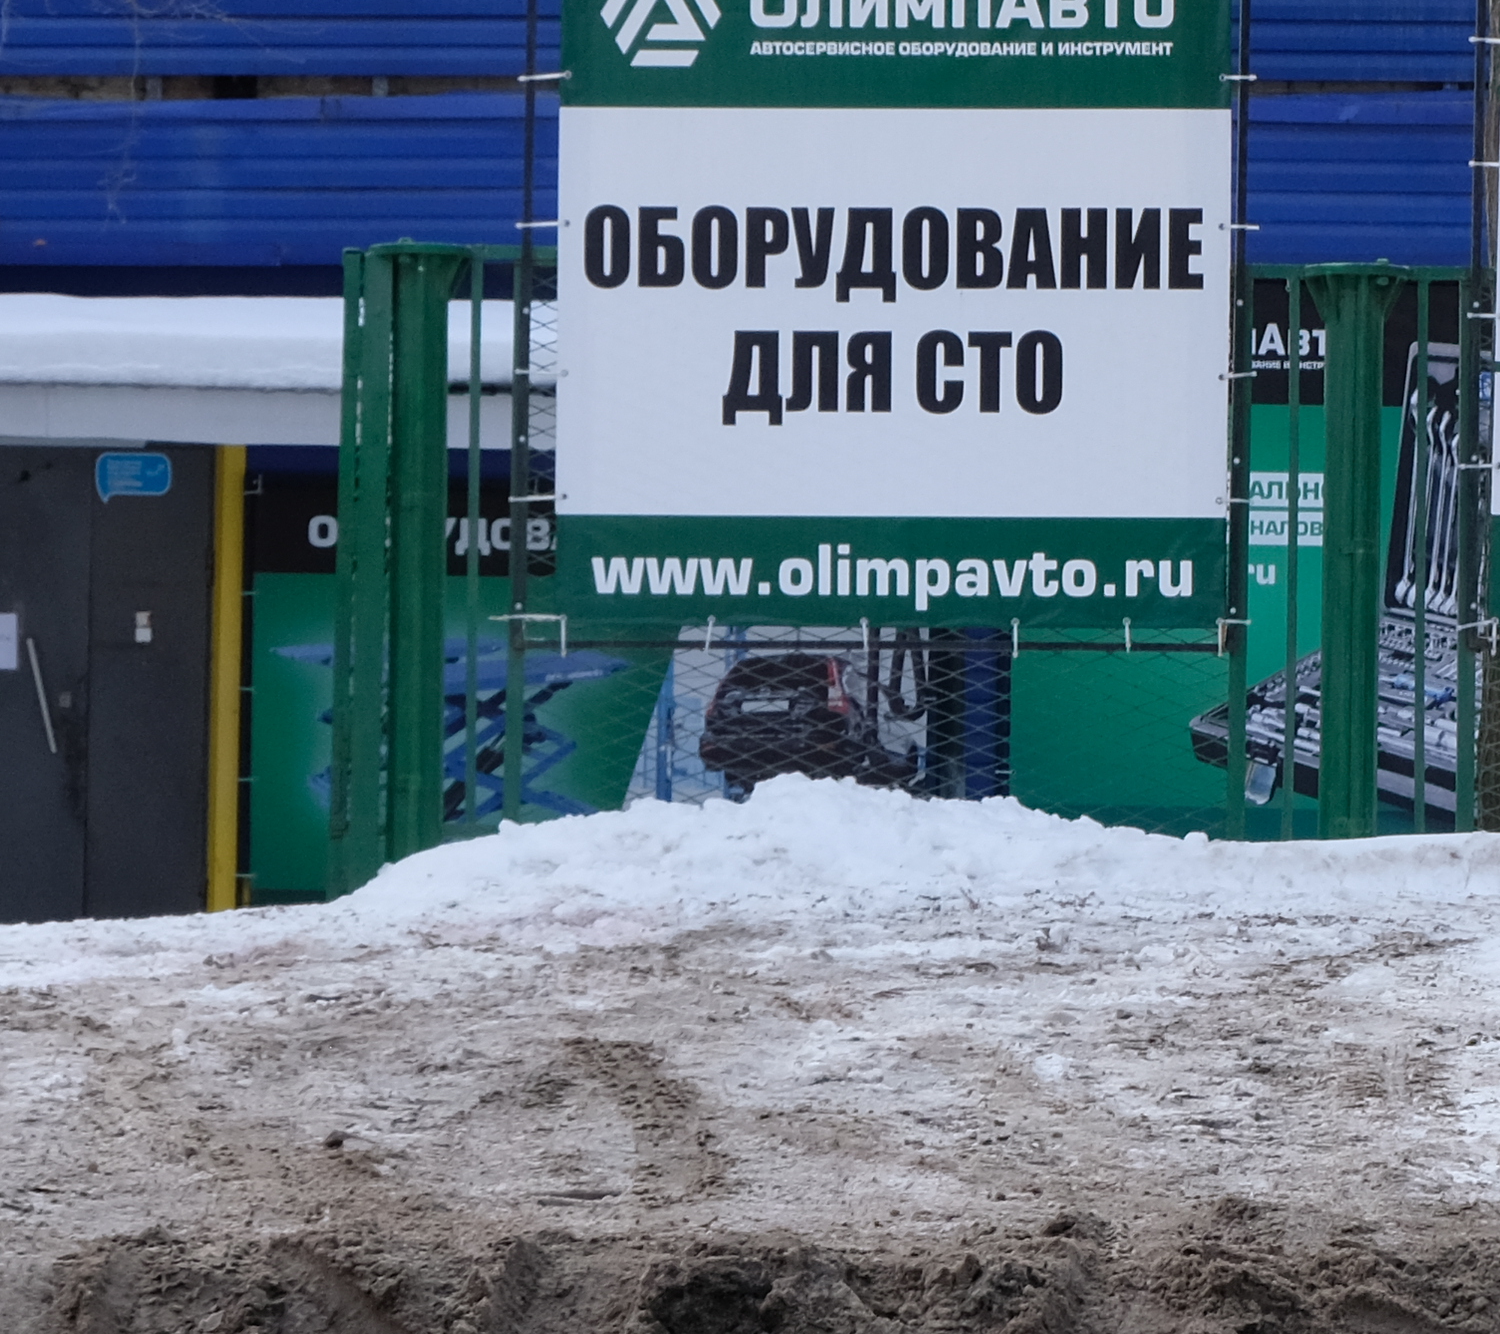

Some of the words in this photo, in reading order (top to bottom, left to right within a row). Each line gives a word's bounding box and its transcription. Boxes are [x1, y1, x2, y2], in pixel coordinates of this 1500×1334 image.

[750, 41, 895, 55] АВТОСЕРВИСНОЕ
[899, 42, 1037, 57] ОБОРУДОВАНИЕ
[1041, 42, 1054, 55] И
[1058, 41, 1173, 56] ИНСТРУМЕНТ
[584, 204, 1204, 303] ОБОРУДОВАНИЕ
[721, 330, 892, 426] ДЛЯ
[916, 330, 1063, 415] СТО
[592, 544, 1192, 611] www.olimpavto.ru
